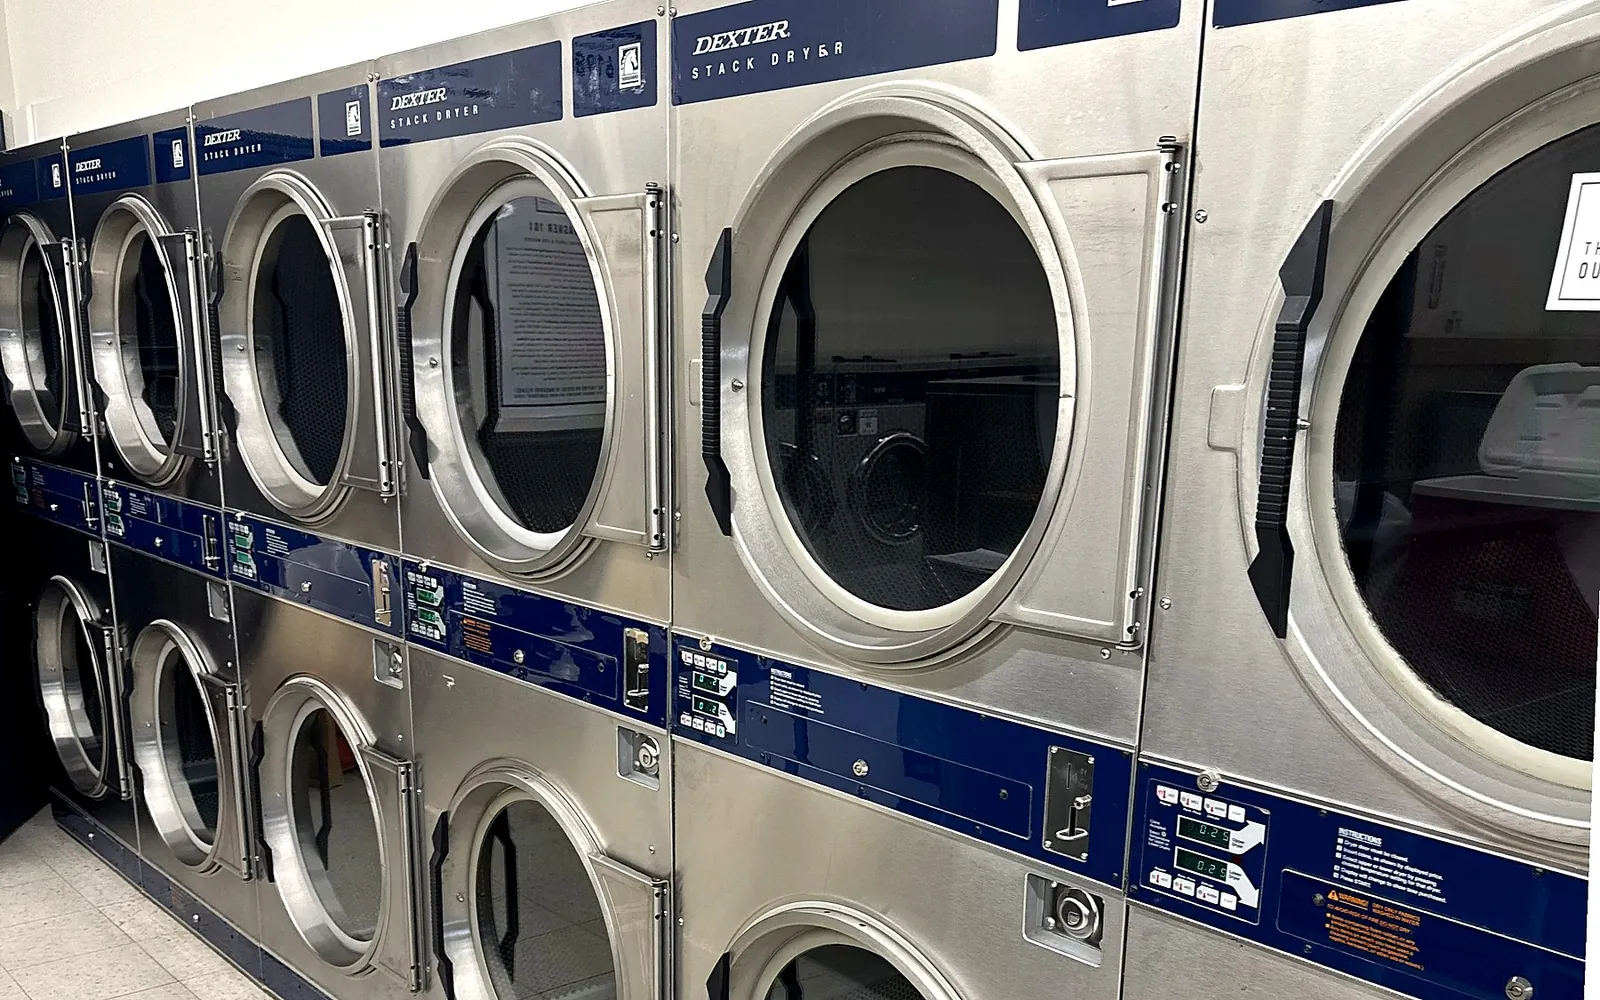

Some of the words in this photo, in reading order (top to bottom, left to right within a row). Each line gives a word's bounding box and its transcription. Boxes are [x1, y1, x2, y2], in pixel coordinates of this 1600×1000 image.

[691, 57, 755, 80] STACK
[771, 41, 843, 66] DRYER
[390, 87, 447, 111] DEXTER
[390, 113, 428, 129] STACK
[436, 104, 479, 121] DRYER
[204, 128, 241, 147] DEXTER
[204, 149, 229, 161] STACK
[234, 143, 262, 156] DRYER
[75, 158, 101, 173] DEXTER
[1338, 827, 1382, 846] INSTRUCTIONS
